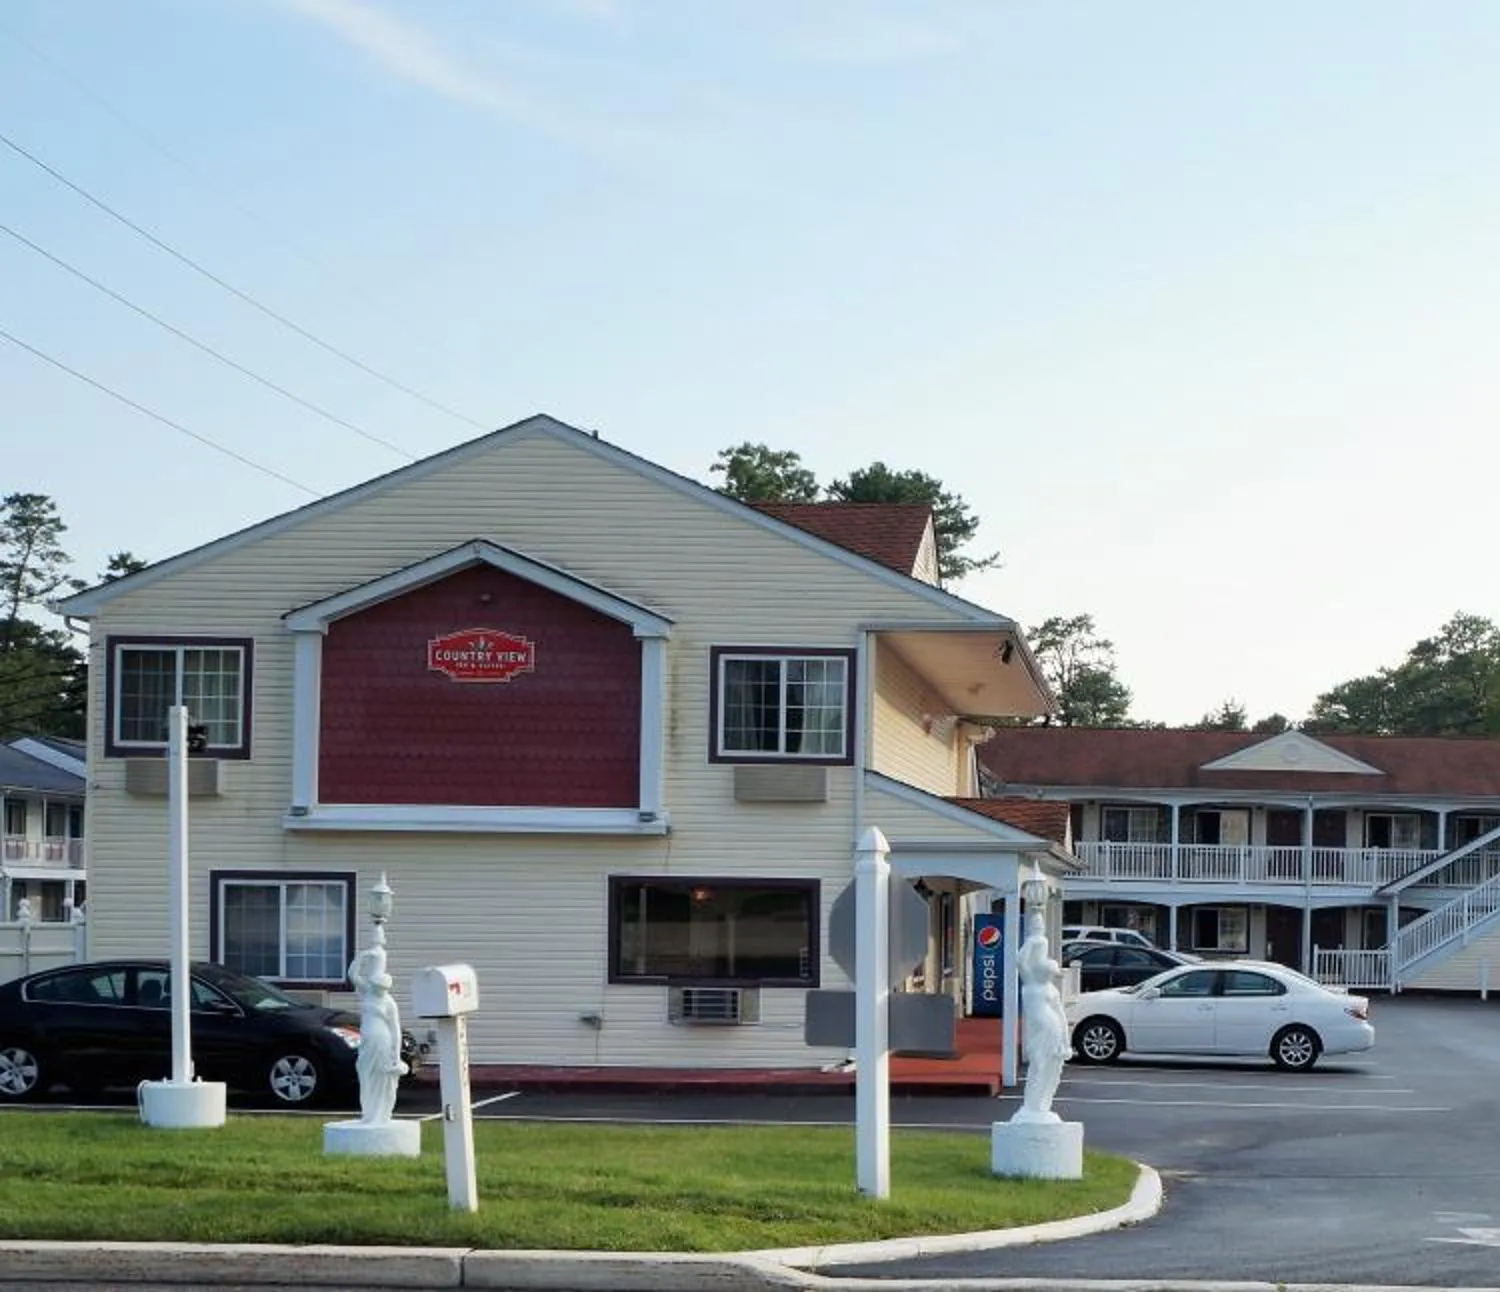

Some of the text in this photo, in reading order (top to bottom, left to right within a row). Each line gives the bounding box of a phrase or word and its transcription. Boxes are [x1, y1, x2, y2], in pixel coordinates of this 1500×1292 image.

[435, 650, 527, 663] COUNTRY VIEW
[983, 954, 997, 1001] pepsi
